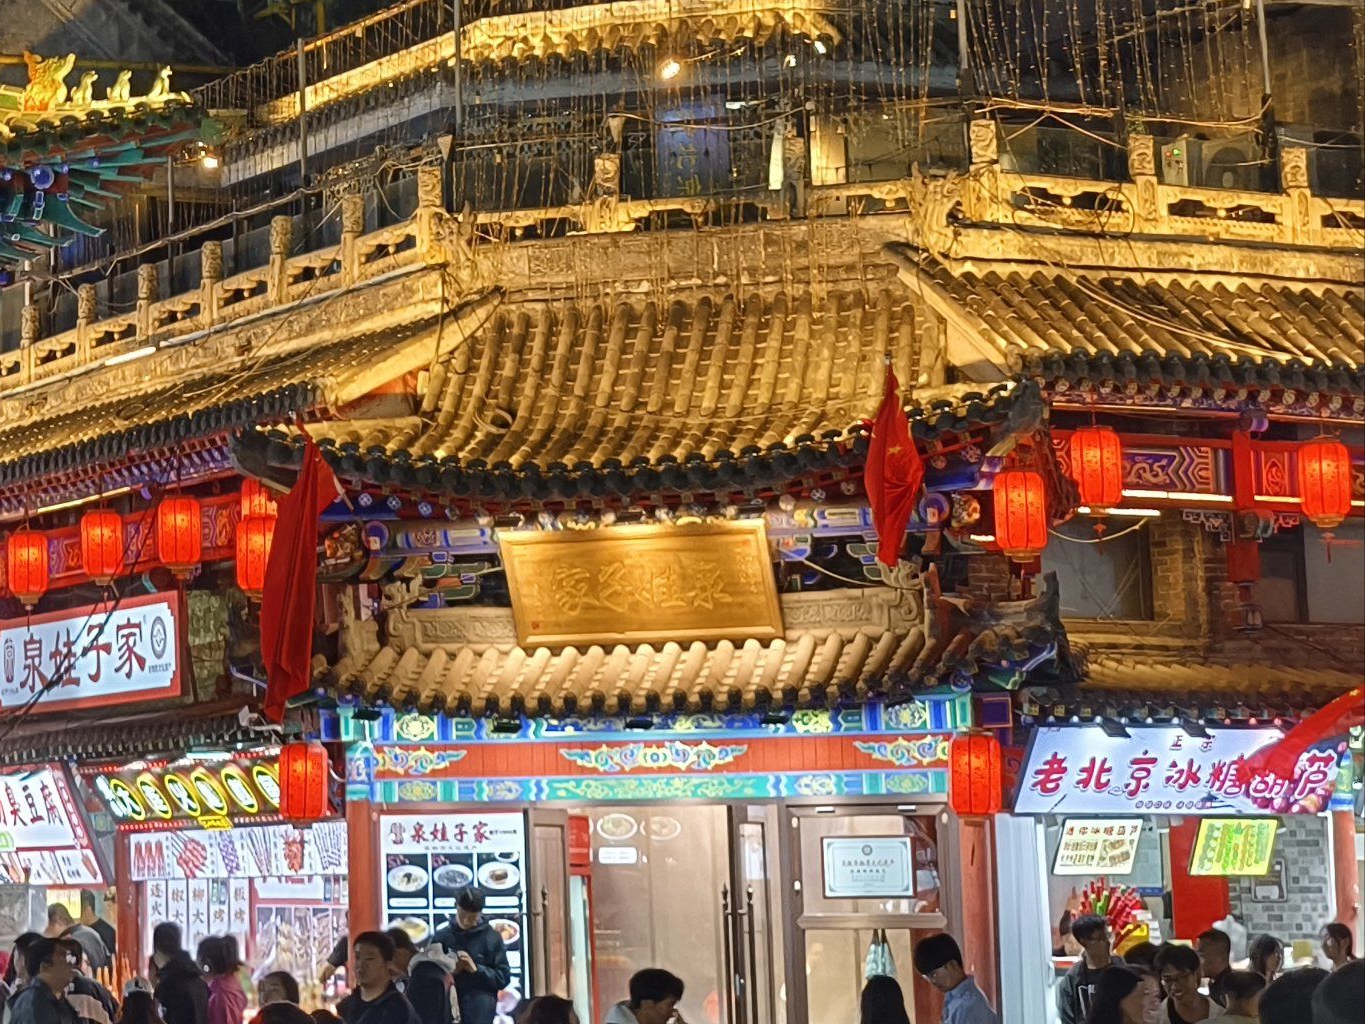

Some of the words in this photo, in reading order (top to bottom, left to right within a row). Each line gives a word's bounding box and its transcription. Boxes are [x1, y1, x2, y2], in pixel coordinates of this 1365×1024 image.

[20, 615, 147, 693] 泉娃子家
[411, 821, 491, 844] 泉娃子家
